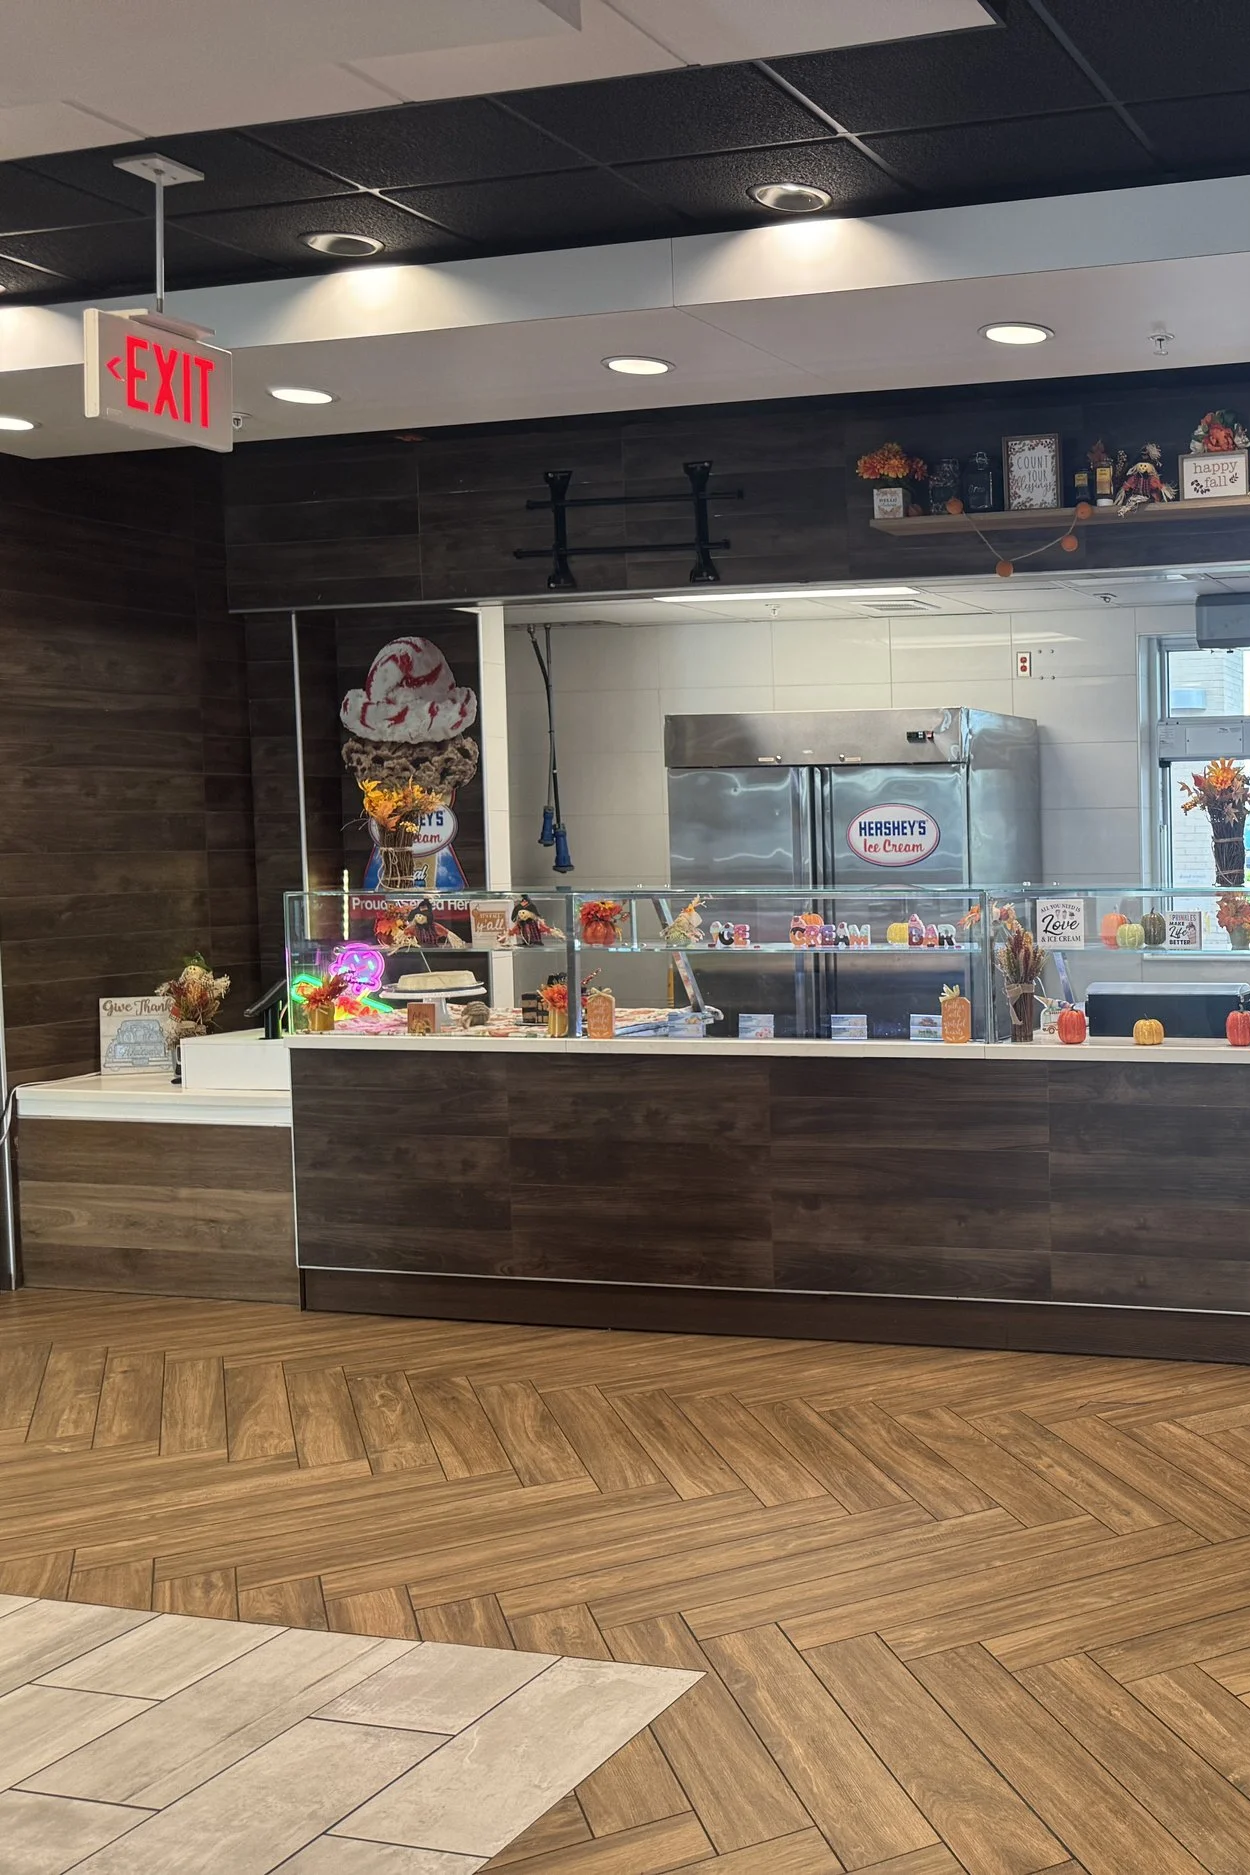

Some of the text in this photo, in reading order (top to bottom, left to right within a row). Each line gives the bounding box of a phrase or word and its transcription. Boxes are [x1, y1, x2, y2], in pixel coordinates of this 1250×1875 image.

[126, 334, 214, 429] EXIT
[1017, 455, 1049, 469] COUNT
[1193, 461, 1238, 475] happy
[1028, 469, 1047, 482] YOUR
[1205, 476, 1228, 488] fall
[859, 820, 926, 836] HERSHEY'S
[863, 839, 924, 853] Ice Cream
[476, 918, 506, 932] y'all
[790, 916, 871, 946] CREAM
[1041, 914, 1079, 935] Love
[1169, 926, 1188, 939] Life
[102, 998, 173, 1016] Give Thank
